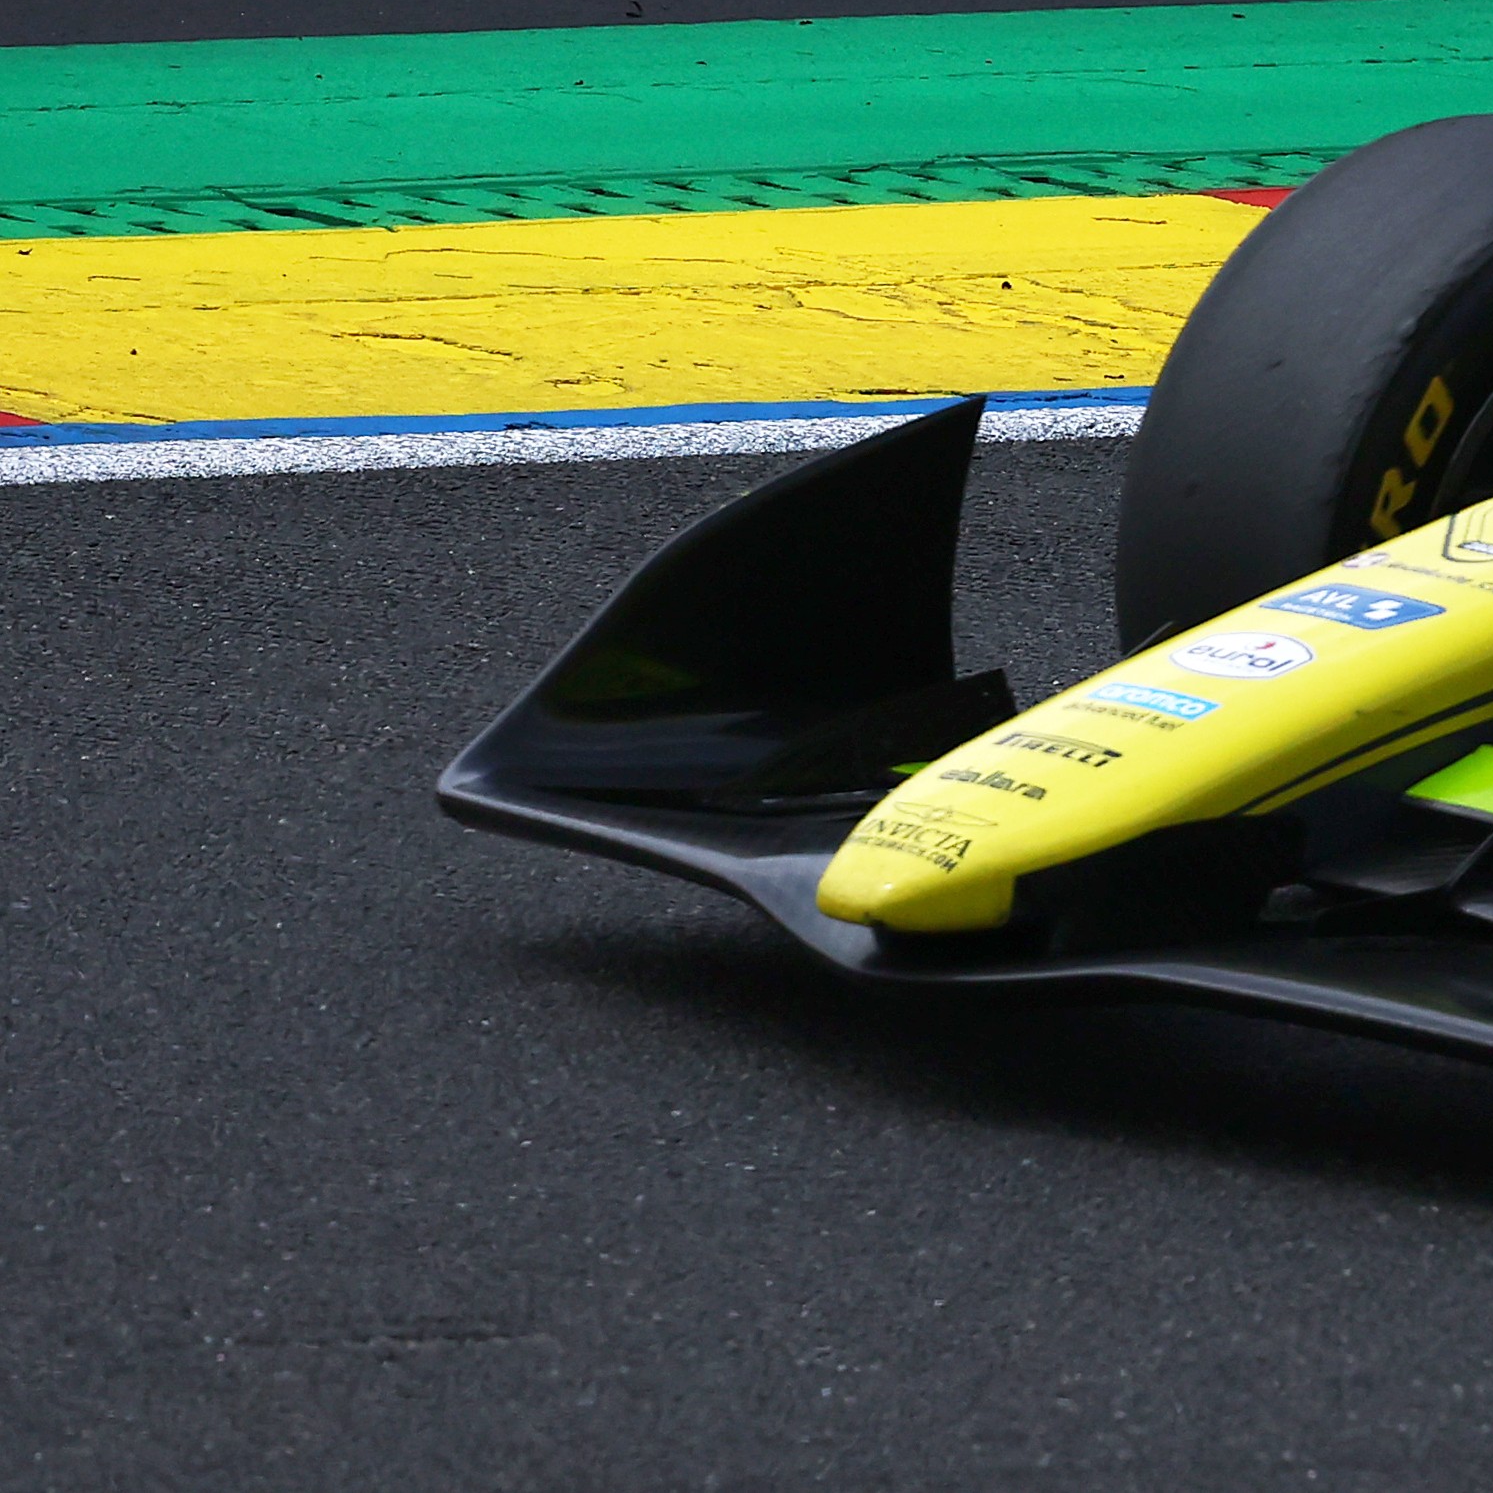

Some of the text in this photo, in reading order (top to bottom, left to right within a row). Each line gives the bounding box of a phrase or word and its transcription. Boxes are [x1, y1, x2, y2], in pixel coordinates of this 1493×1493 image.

[1300, 589, 1361, 609] AVL
[1187, 644, 1294, 672] eurol
[994, 731, 1122, 768] PIRELLI
[860, 818, 974, 859] INVICTA
